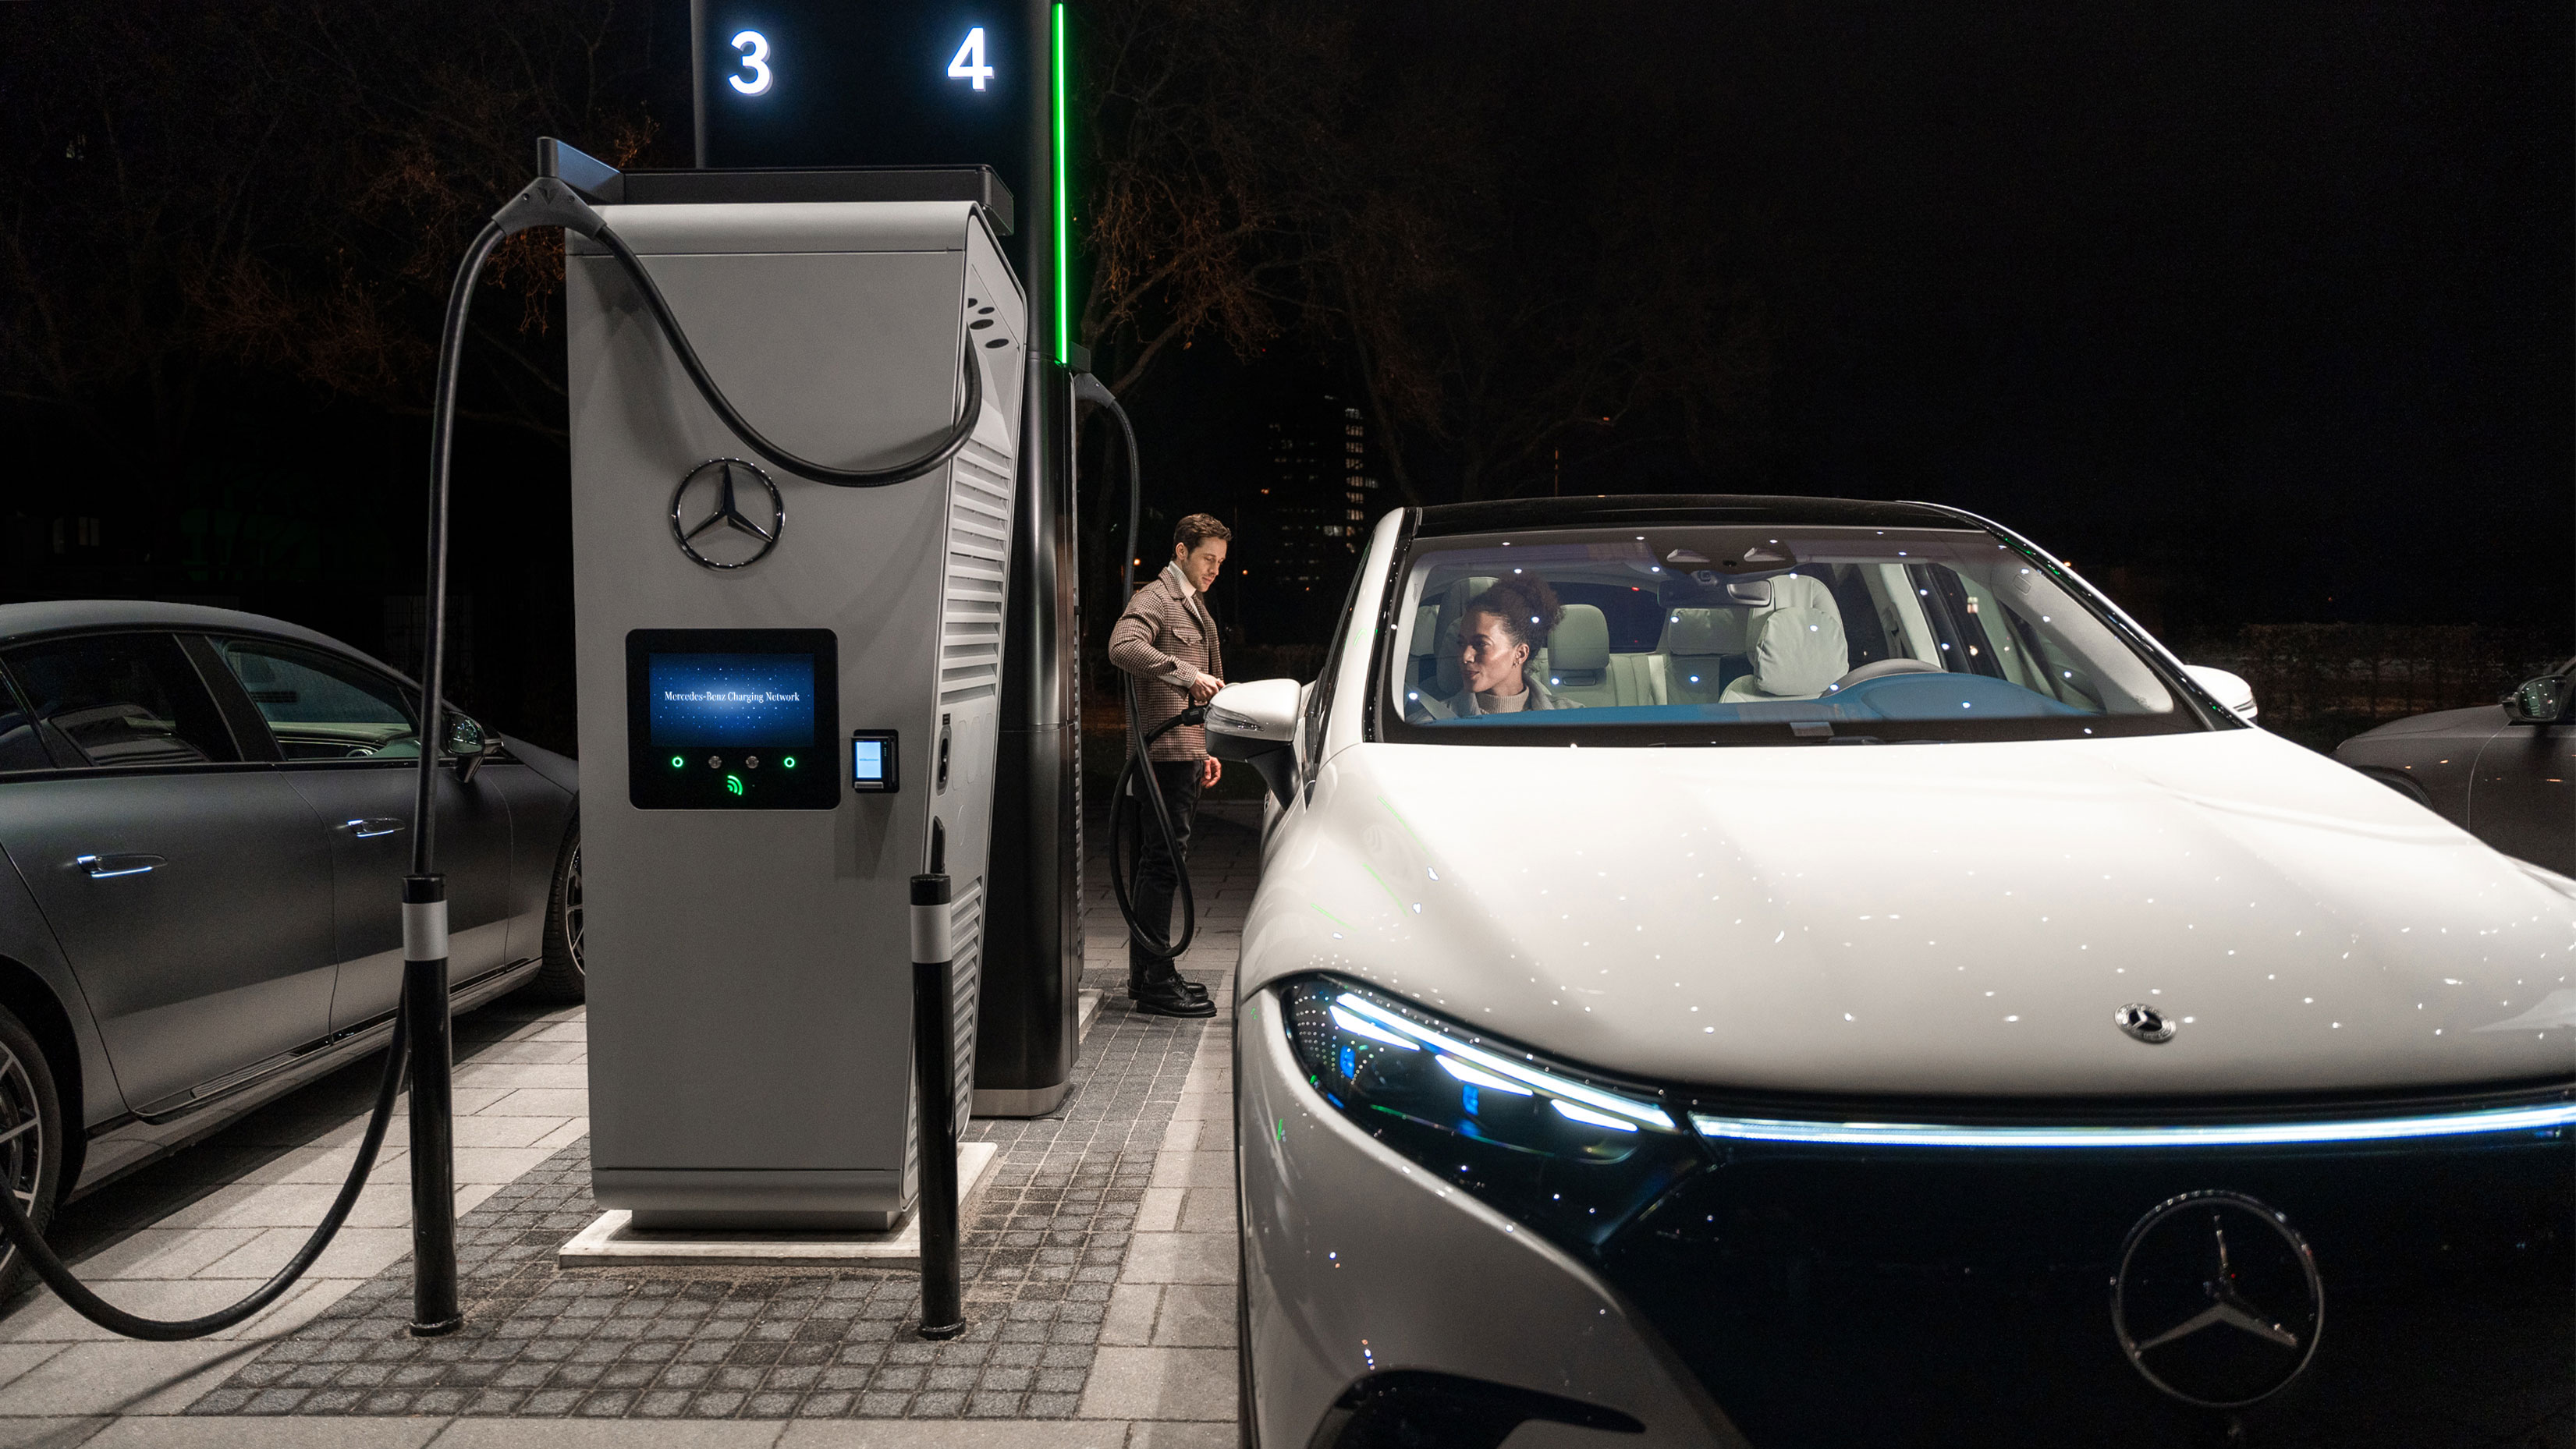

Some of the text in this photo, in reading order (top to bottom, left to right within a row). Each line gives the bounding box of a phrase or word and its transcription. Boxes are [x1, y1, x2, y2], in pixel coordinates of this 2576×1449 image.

[729, 30, 772, 95] 3
[947, 27, 994, 90] 4
[665, 691, 800, 703] Mercedes-Benz Charging Network
